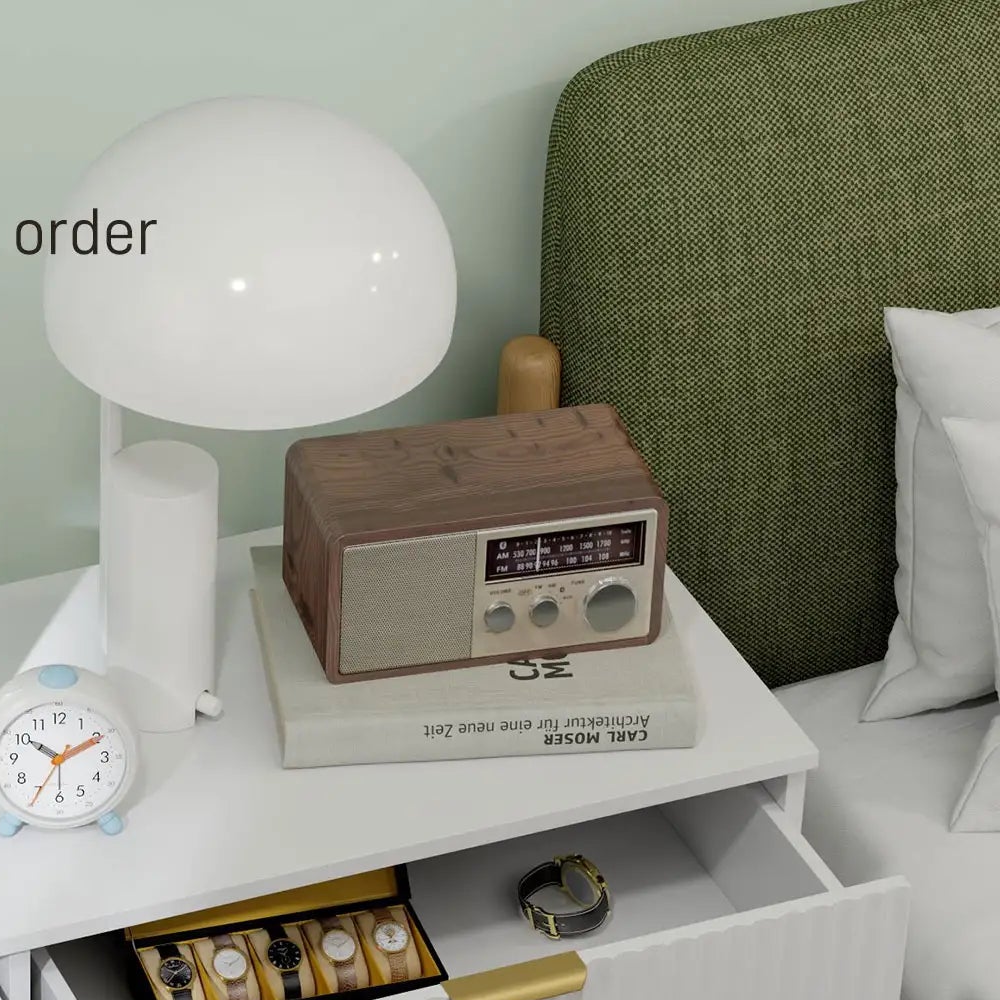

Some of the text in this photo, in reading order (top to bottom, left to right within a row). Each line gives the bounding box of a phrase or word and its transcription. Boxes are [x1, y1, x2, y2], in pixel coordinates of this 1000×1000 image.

[496, 552, 509, 560] AM
[496, 565, 508, 573] FM
[32, 718, 45, 731] 11
[53, 711, 67, 725] 12
[78, 717, 84, 731] 1
[423, 714, 651, 740] Architektur für eine neue Zeit
[15, 732, 31, 745] 10
[543, 729, 649, 746] CARL MOSER
[9, 752, 19, 765] 9
[100, 750, 110, 764] 3
[17, 771, 27, 785] 8
[92, 771, 101, 783] 4
[54, 790, 65, 804] 6
[76, 784, 86, 797] 5
